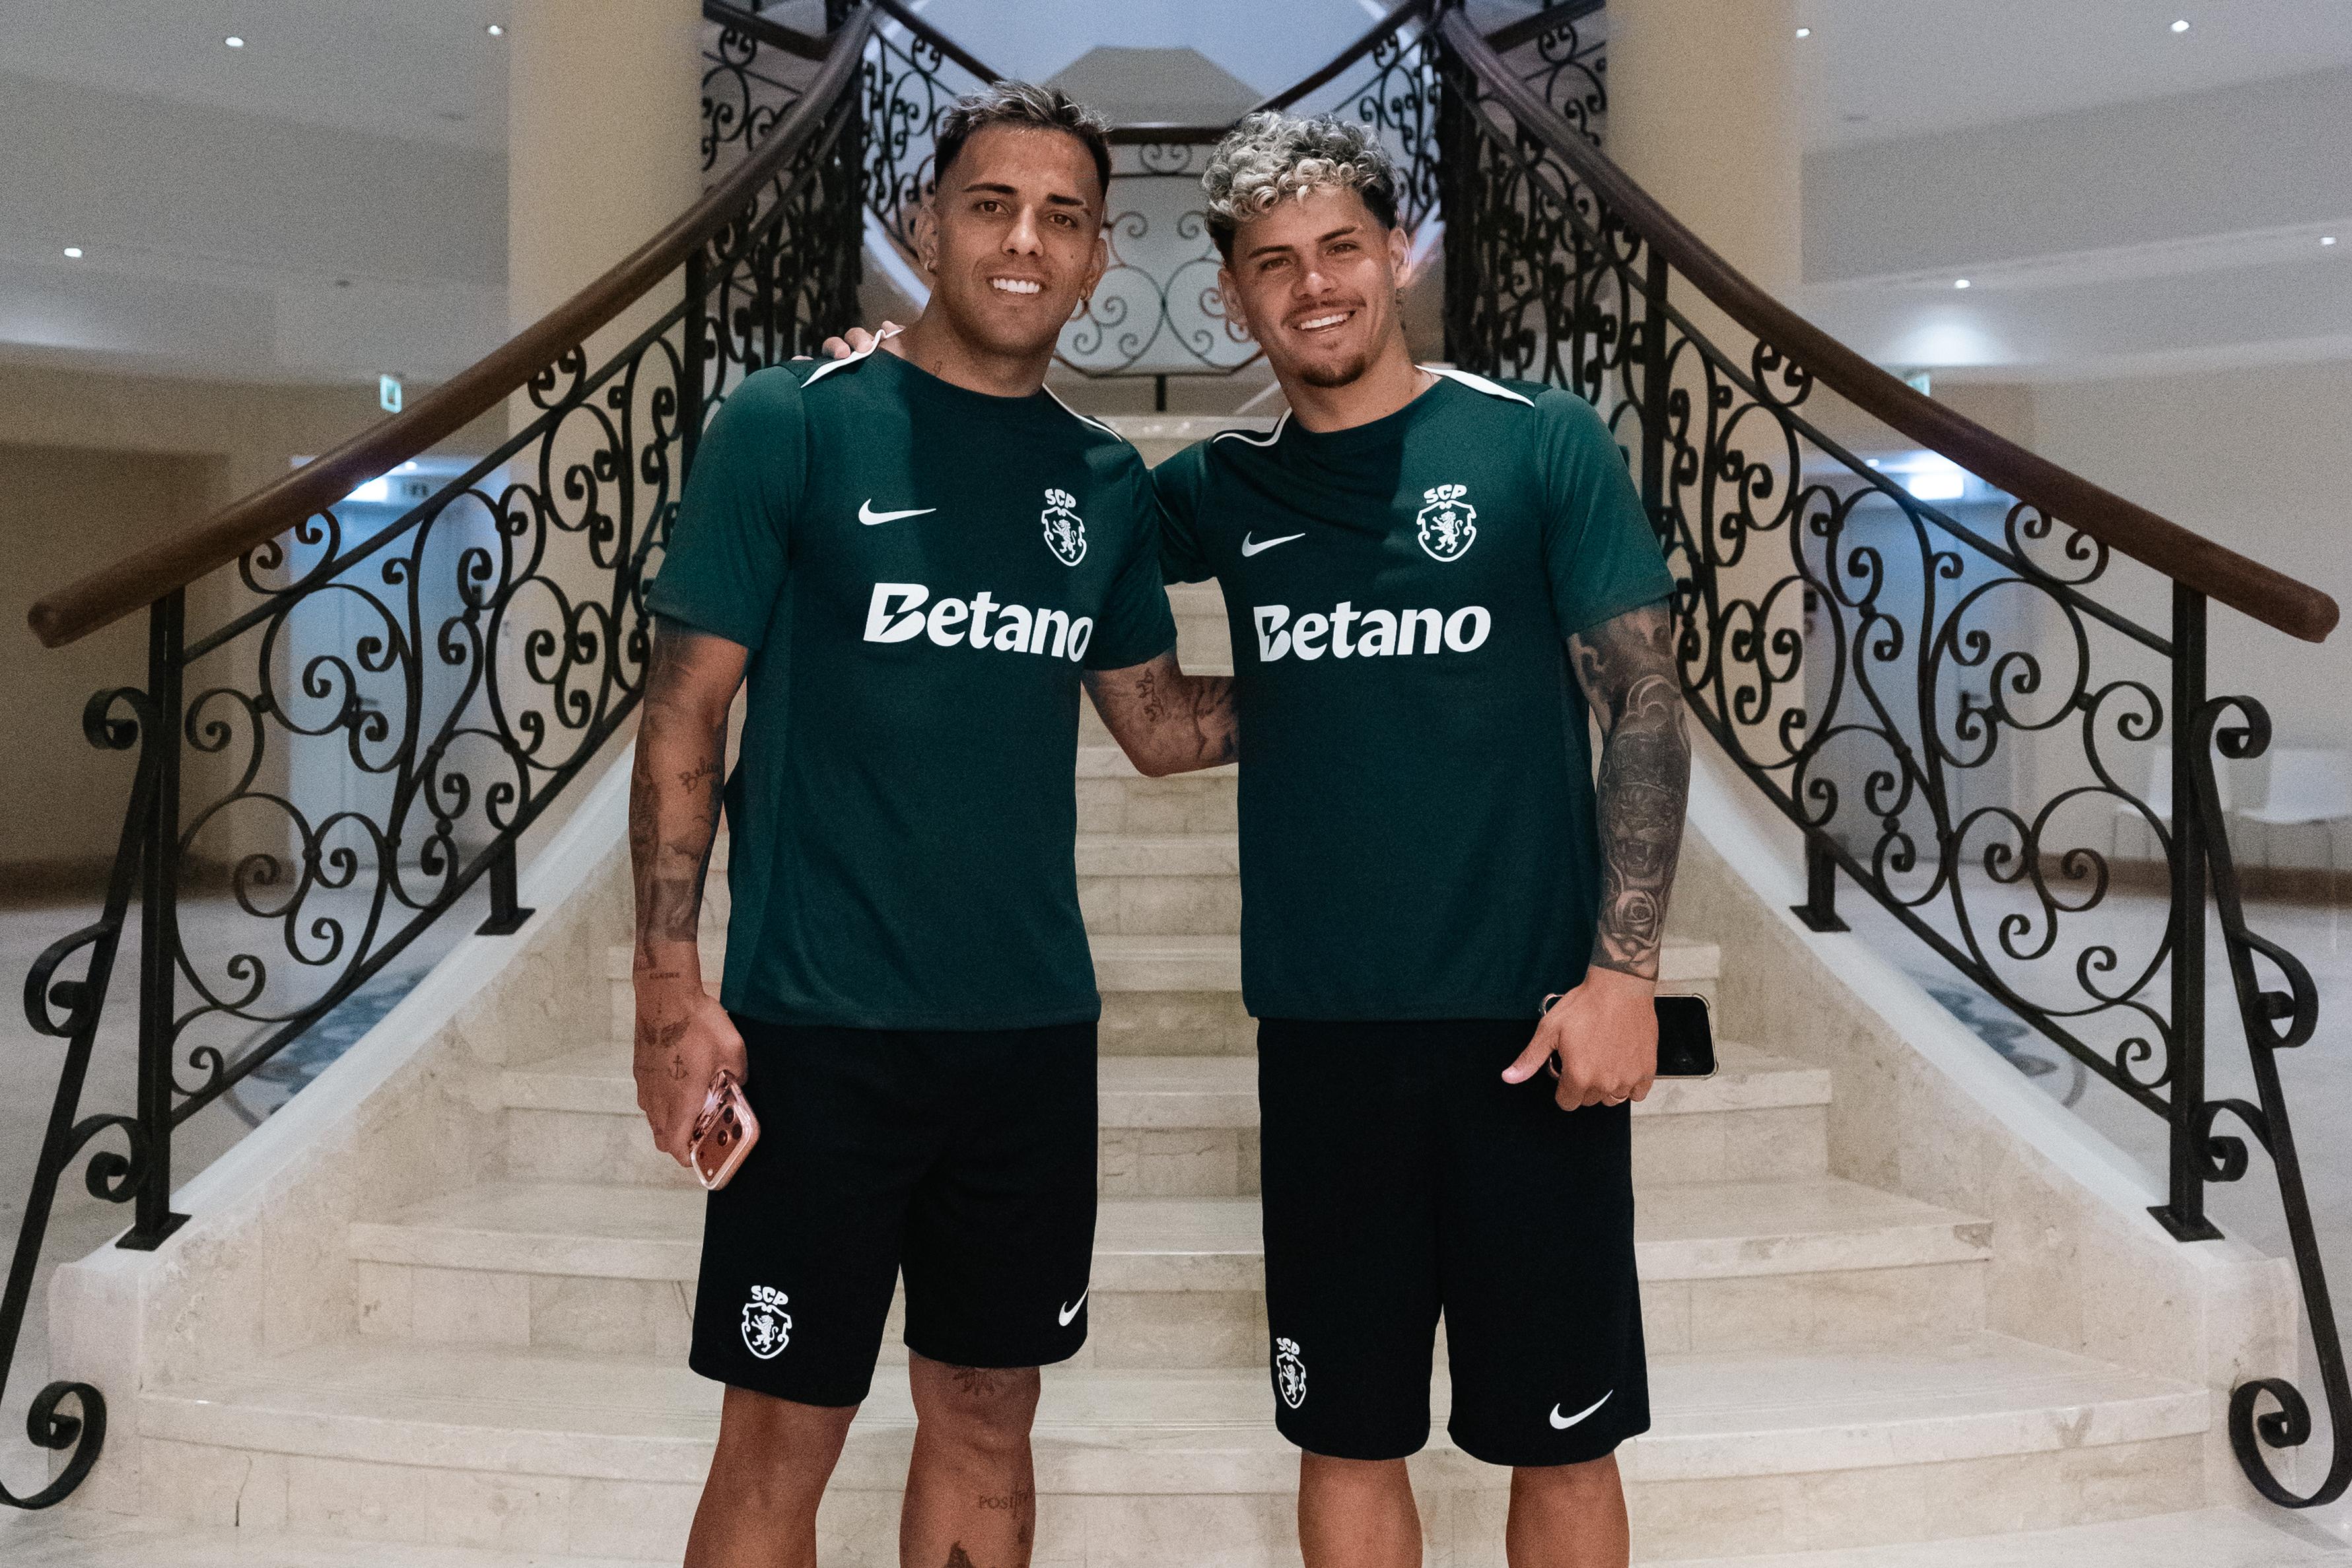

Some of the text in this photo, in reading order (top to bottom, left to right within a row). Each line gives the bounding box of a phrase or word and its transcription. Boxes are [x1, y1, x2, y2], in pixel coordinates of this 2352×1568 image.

[1045, 489, 1076, 508] SCP
[1424, 483, 1467, 504] SCP
[864, 583, 1093, 662] Betano
[1253, 601, 1491, 662] Betano
[751, 1285, 788, 1305] SCP
[1276, 1338, 1300, 1355] SCP
